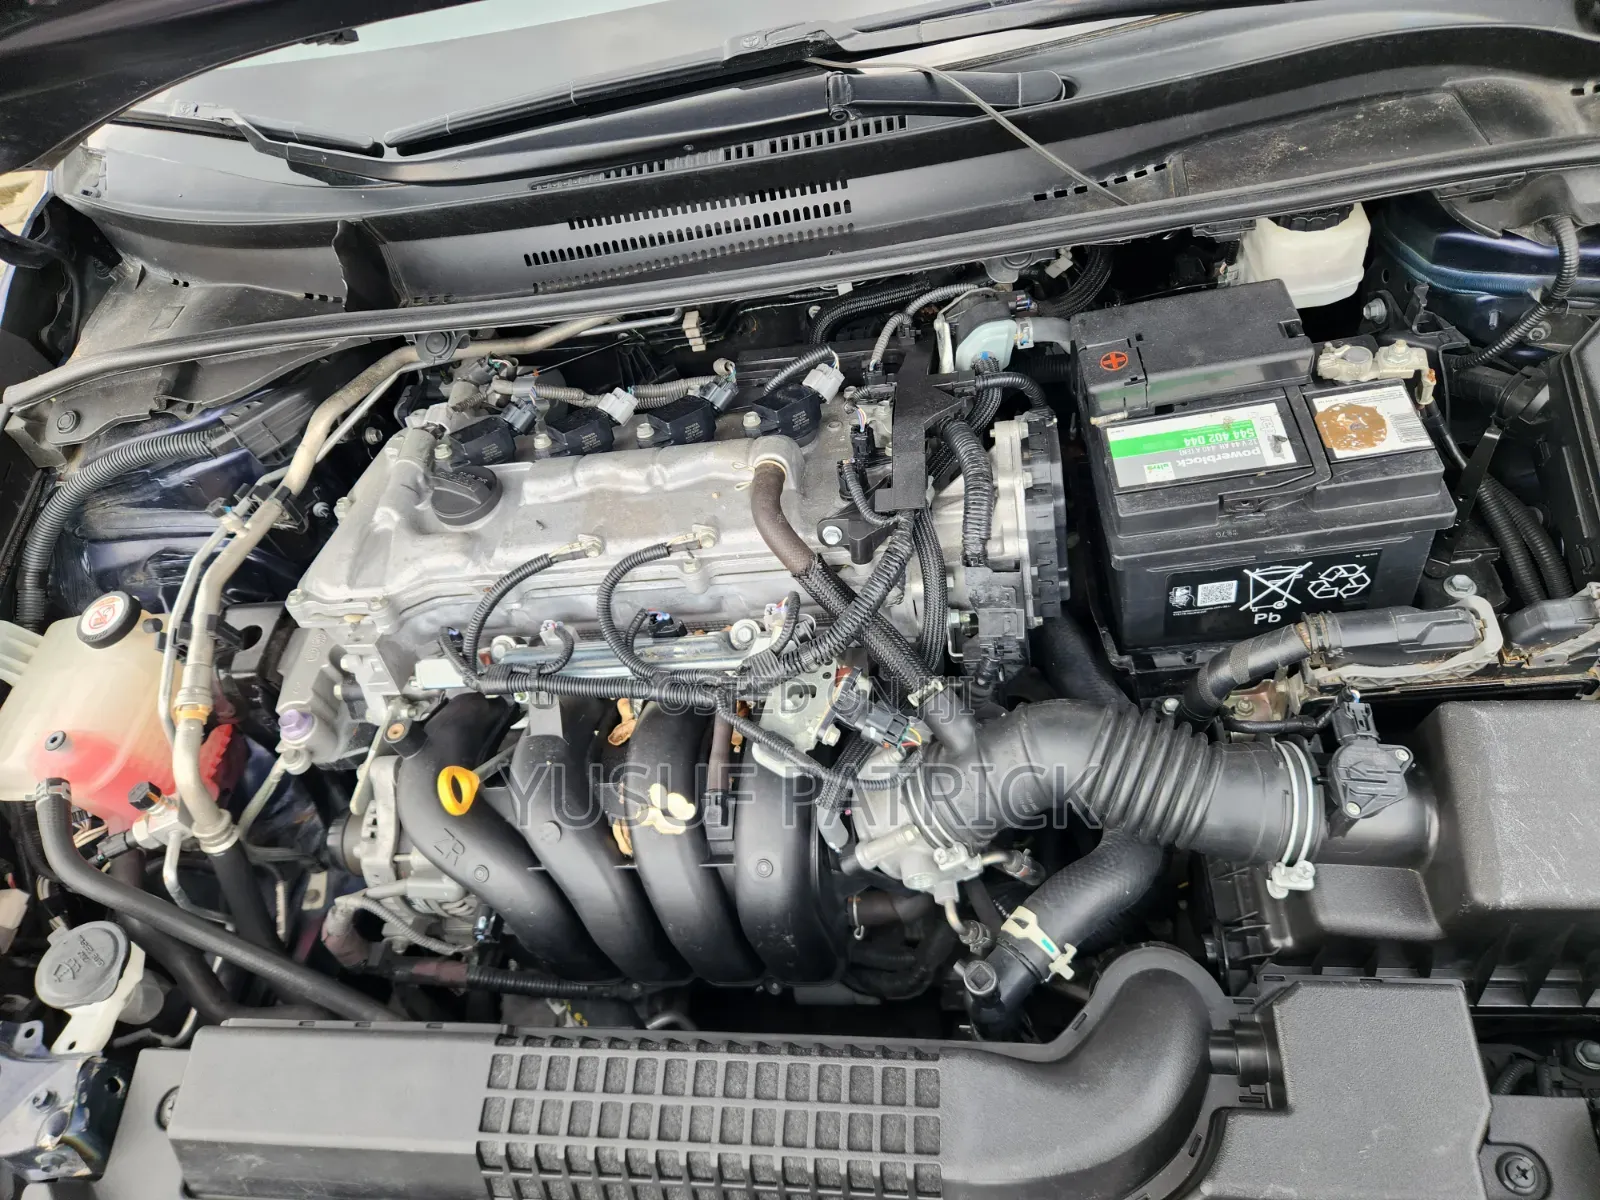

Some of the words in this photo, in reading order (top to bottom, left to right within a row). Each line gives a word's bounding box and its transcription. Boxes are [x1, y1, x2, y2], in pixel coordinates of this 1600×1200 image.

[1208, 431, 1230, 443] 402
[1233, 427, 1255, 440] 544
[1184, 435, 1206, 447] 044
[1175, 446, 1262, 468] powerblock
[1253, 612, 1281, 625] Pb
